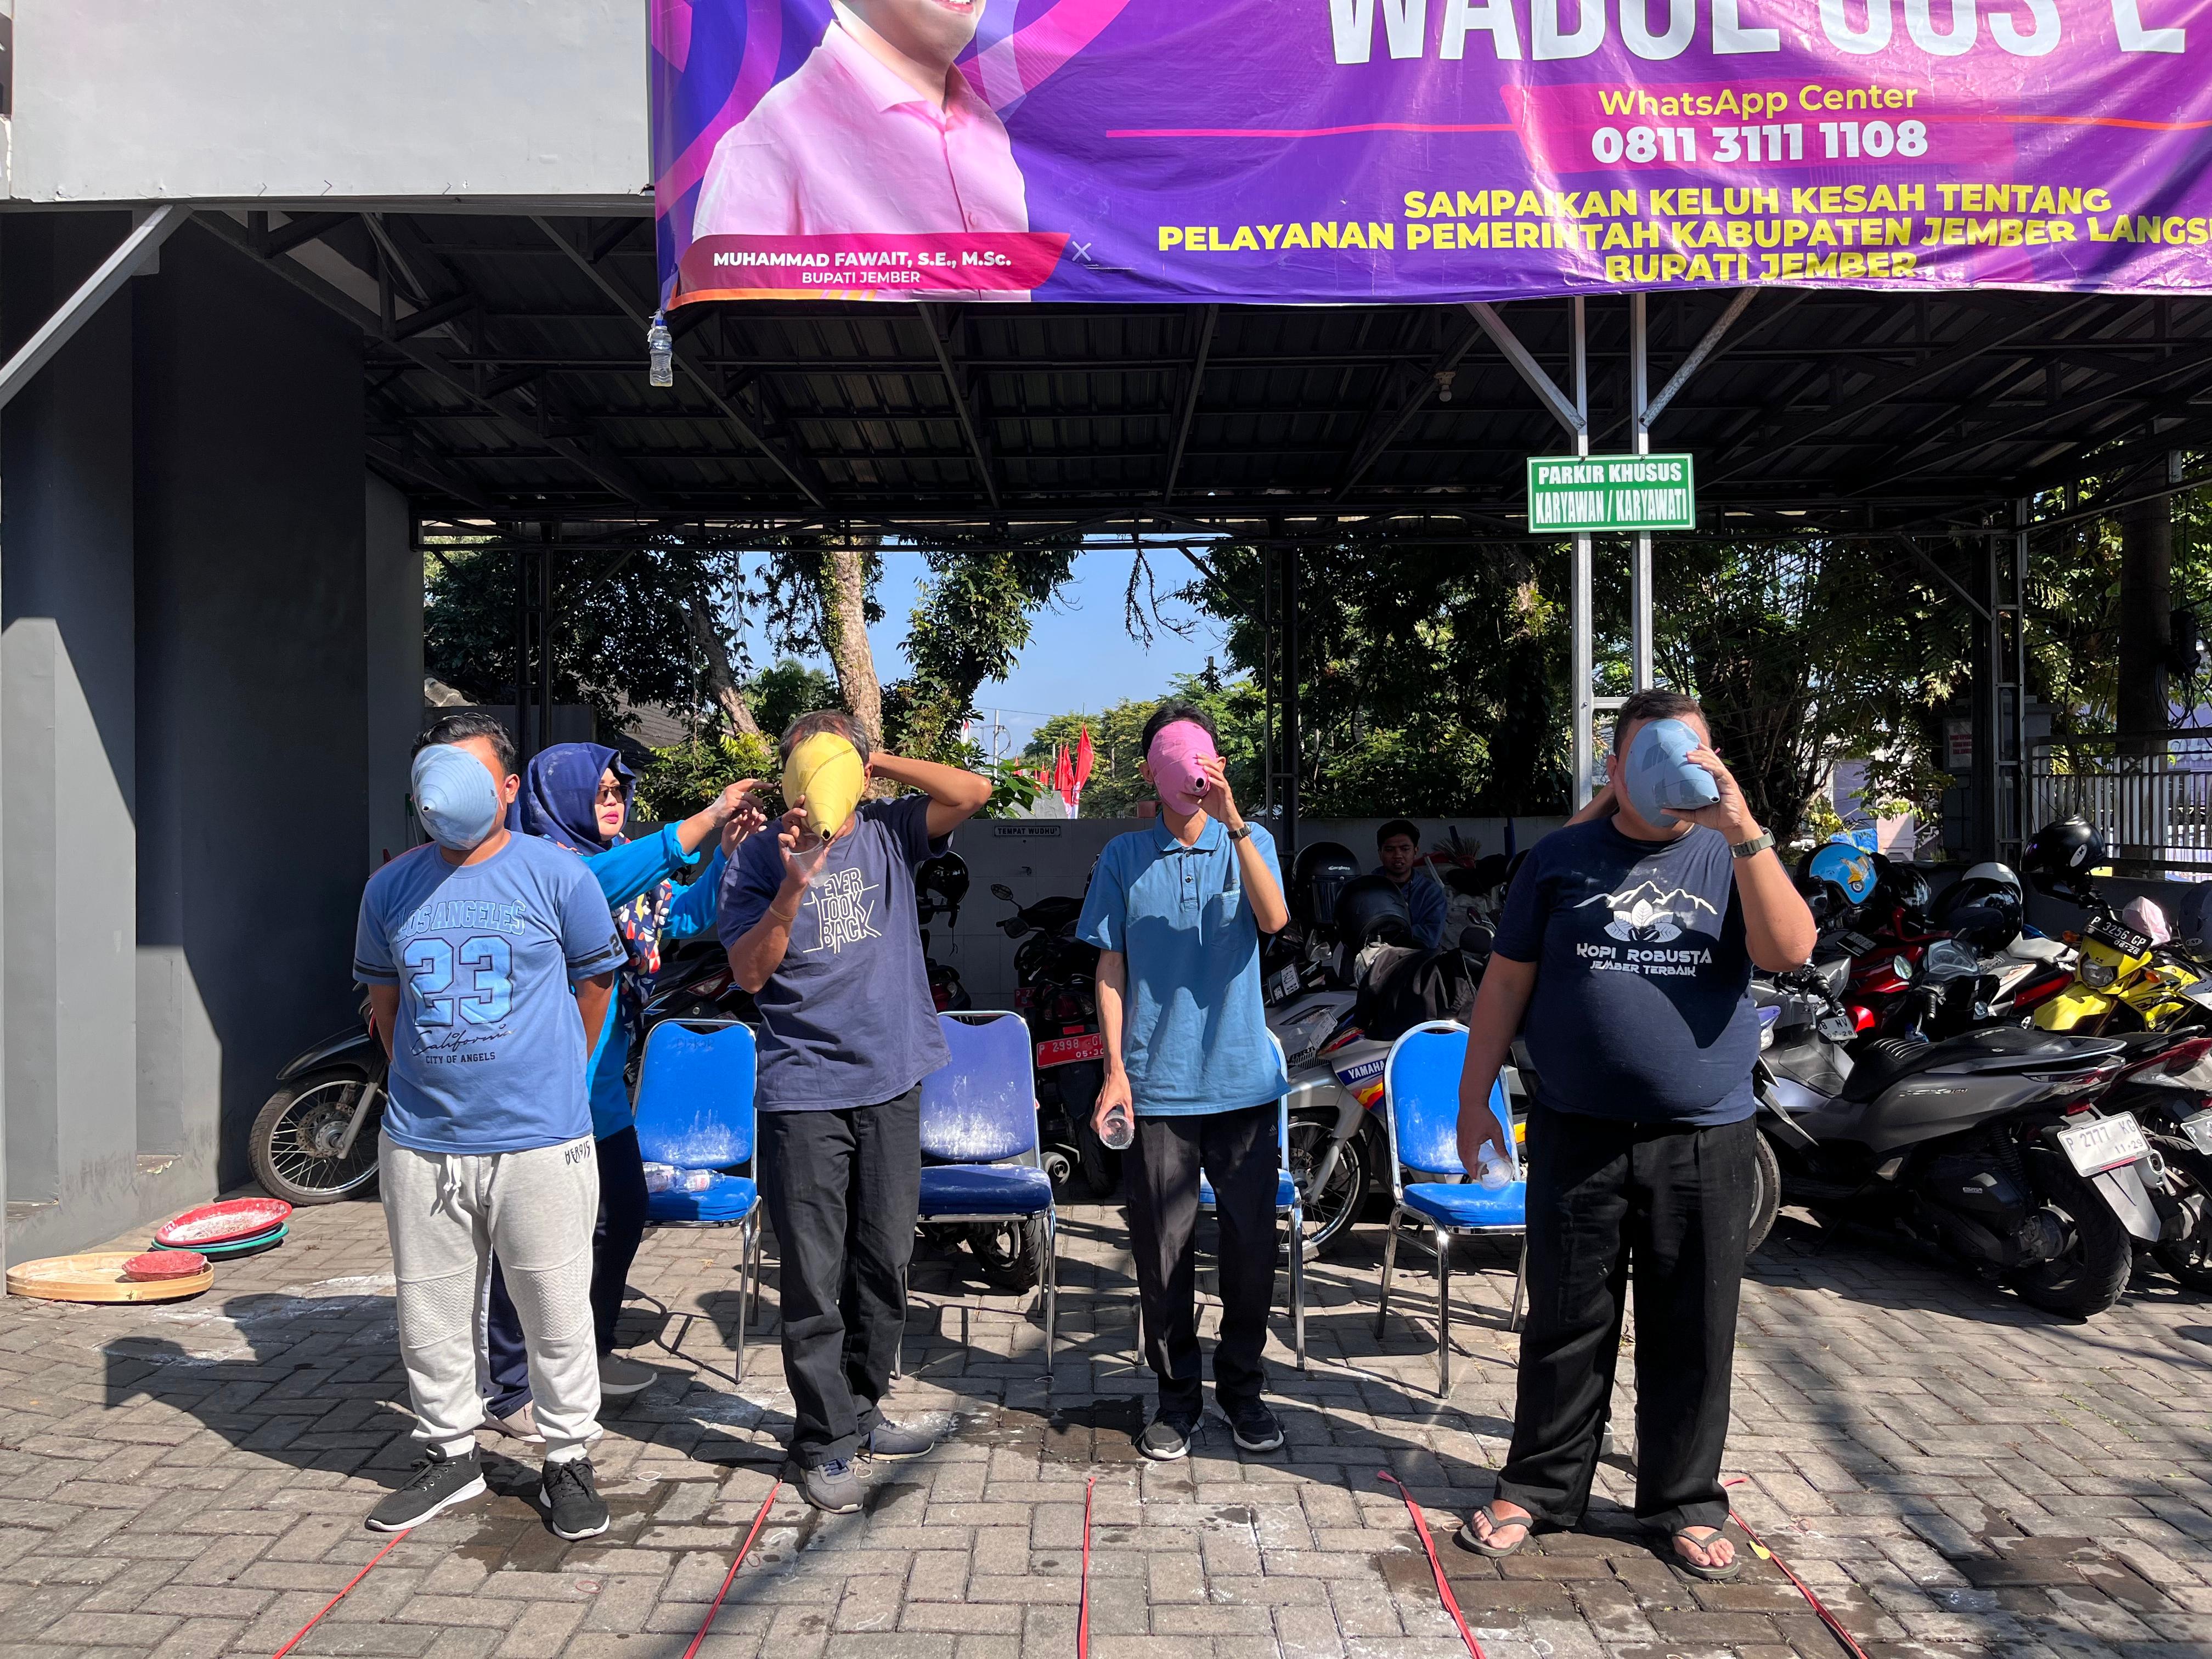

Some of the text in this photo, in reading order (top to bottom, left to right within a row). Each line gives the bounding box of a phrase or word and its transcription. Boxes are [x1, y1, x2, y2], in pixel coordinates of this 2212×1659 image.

[1599, 84, 1918, 120] WhatsApp Center
[1592, 120, 1928, 163] 0811 3111 1108
[1404, 184, 2112, 218] SAMPAIKAN KELUH KESAH TENTANG
[1159, 216, 2212, 250] PELAYANAN PEMERINTAH KABUPATEN JEMBER LANGS
[714, 252, 1011, 269] MUHAMMAD FAWAIT, S.E., M.Sc.
[1606, 251, 1918, 283] BUPATI JEMBER
[802, 271, 920, 284] BUPATI JEMBER
[1539, 462, 1681, 484] PARKIR KHUSUS
[1536, 490, 1604, 523] KARYAWAN
[1616, 488, 1686, 521] KARYAWATI
[814, 867, 864, 899] EVER
[397, 899, 526, 943] LOS ANGELES
[821, 891, 866, 923] LOOK
[822, 915, 882, 953] BACK
[2091, 916, 2147, 946] P 3256 GP
[1577, 943, 1712, 964] KOPI ROBUSTA
[1590, 960, 1696, 977] JEMBER TERBAIK
[403, 935, 513, 1026] 23
[411, 1024, 517, 1056] California
[1039, 1045, 1045, 1055] P
[1053, 1039, 1079, 1052] 2998
[426, 1052, 495, 1064] CITY OF ANGELS
[1348, 1060, 1385, 1079] YAMAHA
[2066, 1119, 2136, 1151] P 2777 KG
[2187, 1126, 2197, 1139] P
